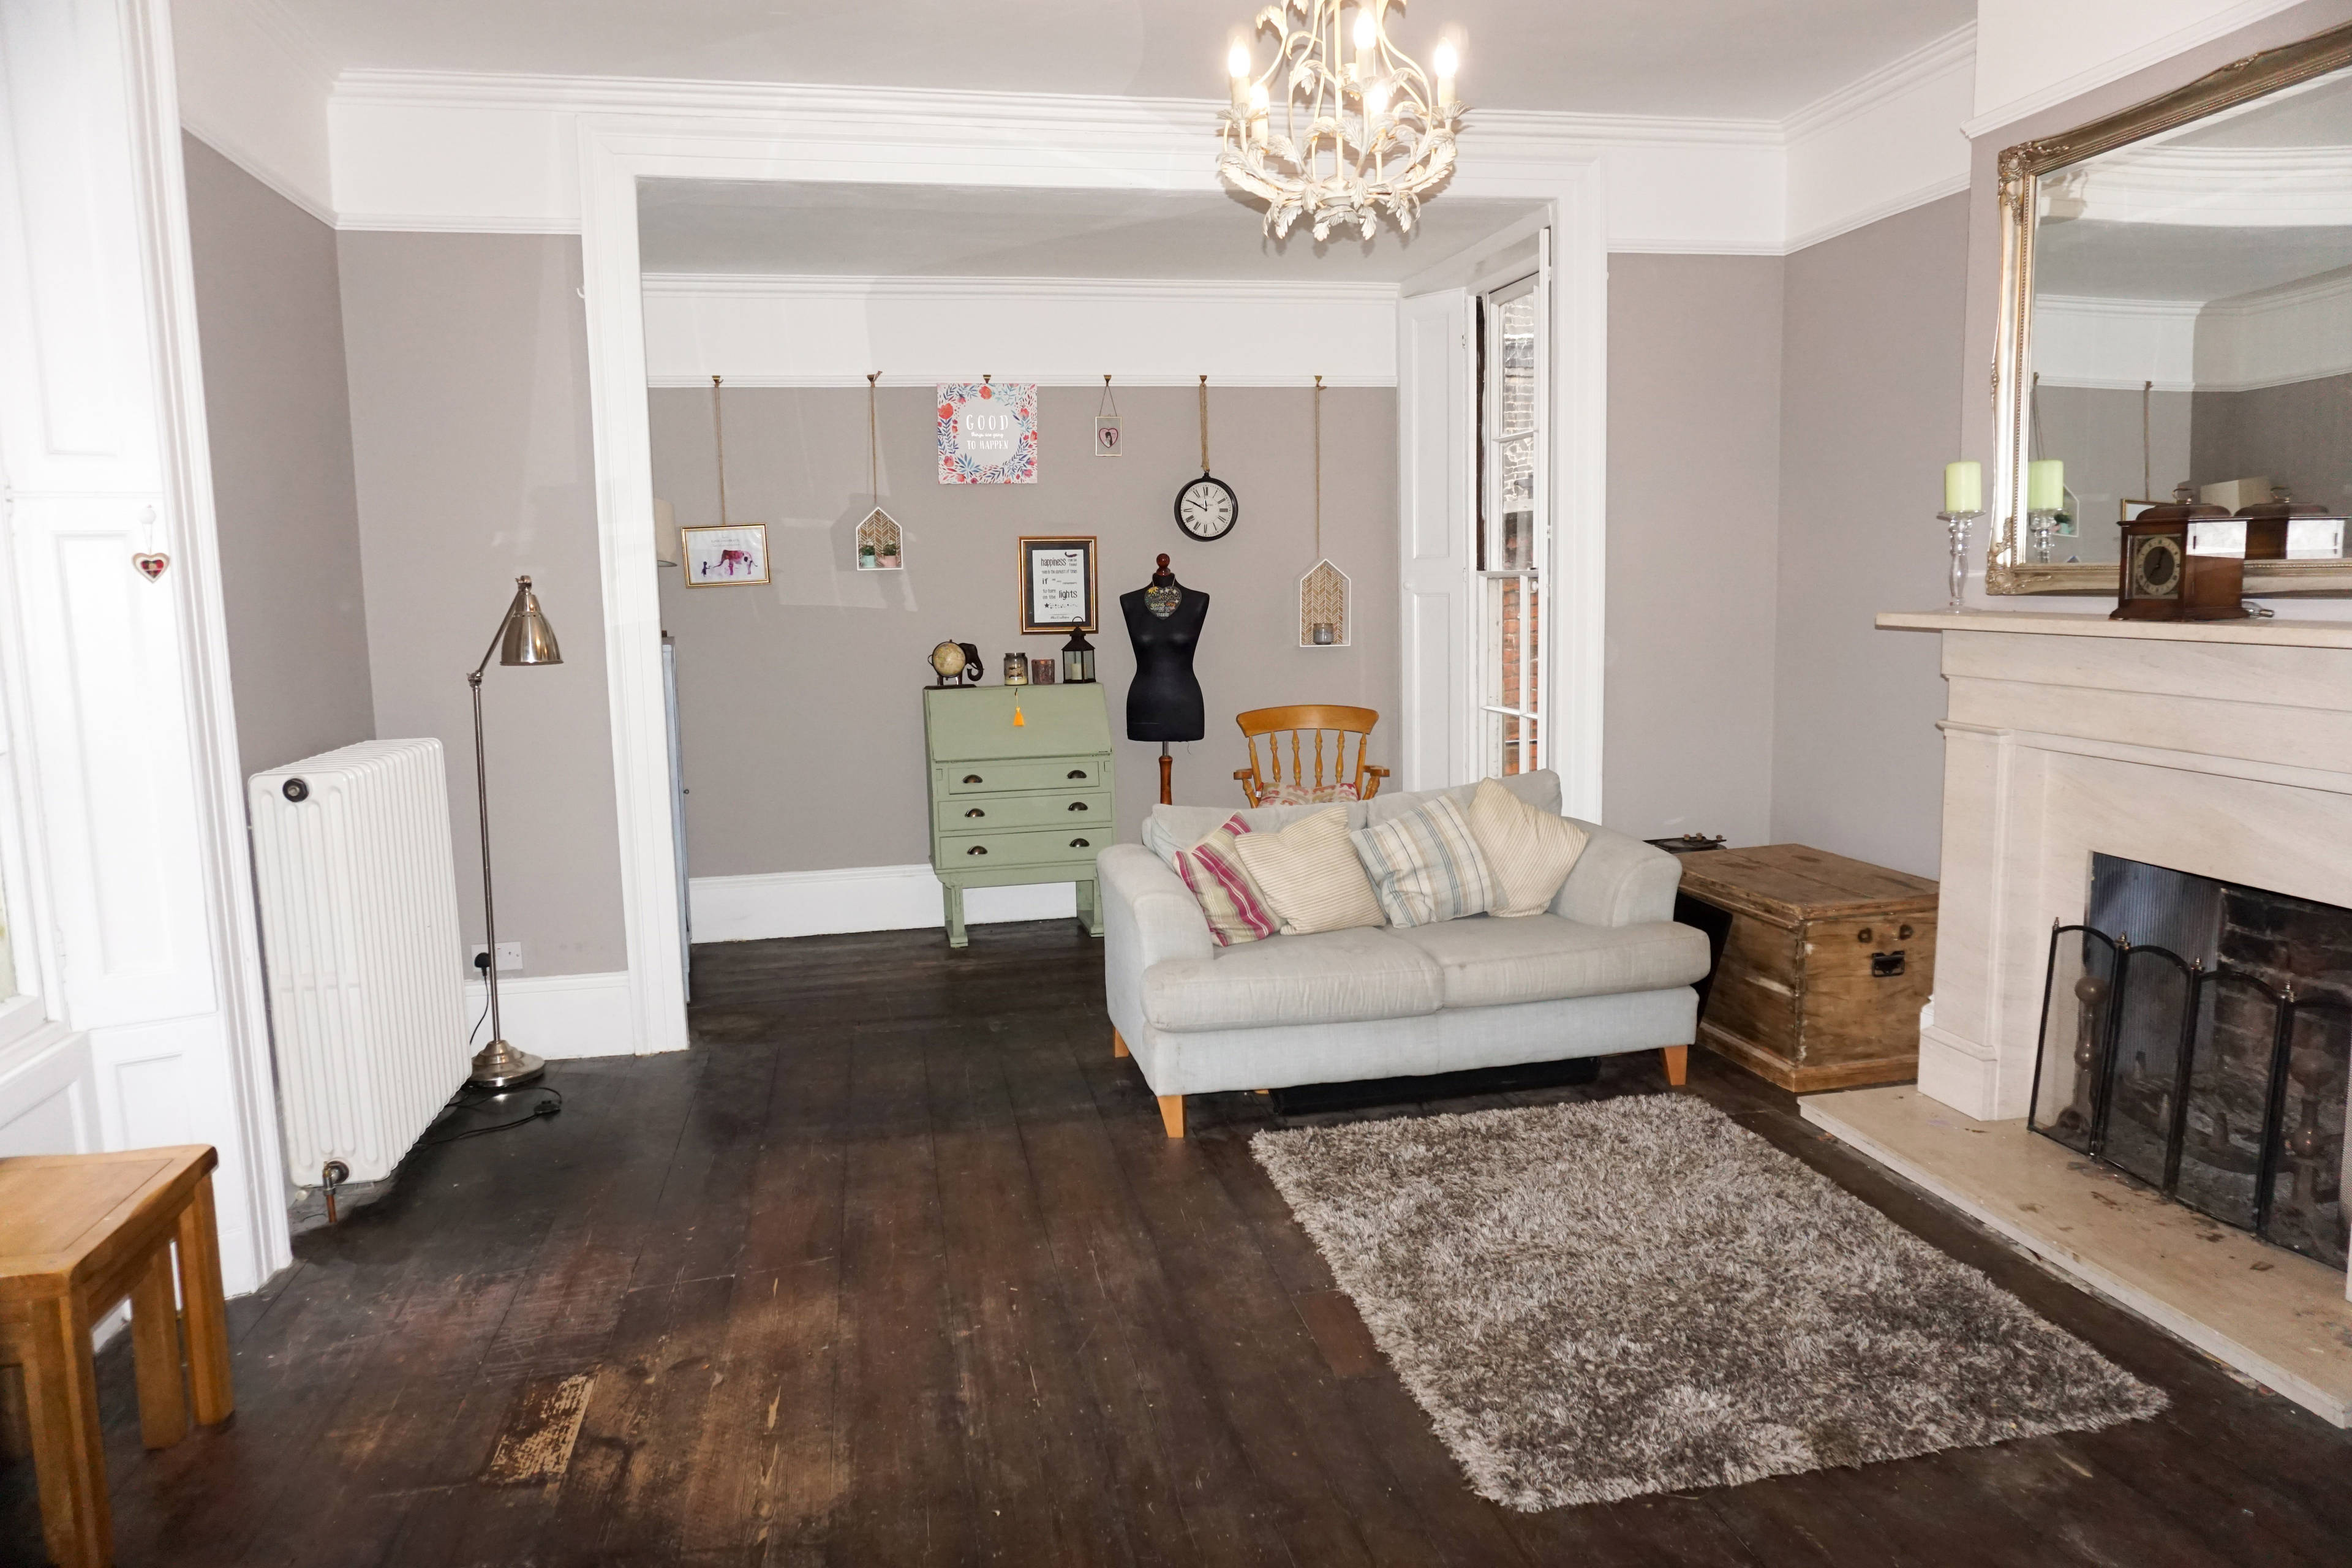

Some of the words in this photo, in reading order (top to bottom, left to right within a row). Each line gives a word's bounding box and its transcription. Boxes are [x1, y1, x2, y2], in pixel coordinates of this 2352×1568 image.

[966, 414, 1008, 431] GOOD
[967, 440, 976, 450] TO
[979, 440, 1009, 450] HAPPEN
[1041, 557, 1066, 567] happiness
[1058, 590, 1078, 600] lights
